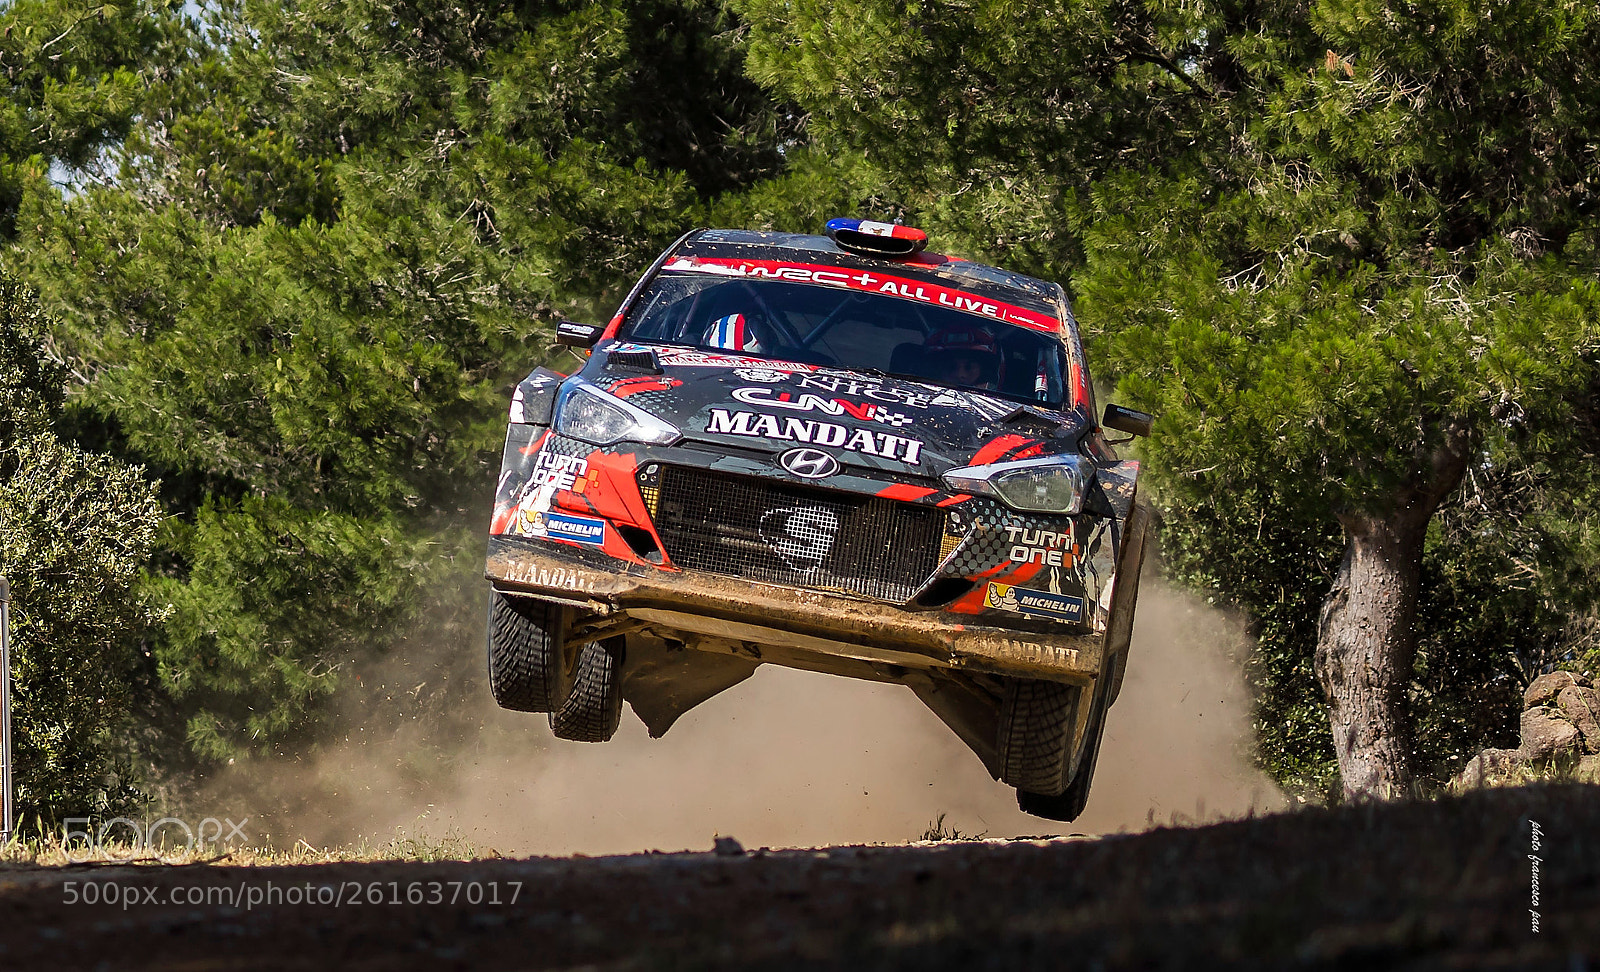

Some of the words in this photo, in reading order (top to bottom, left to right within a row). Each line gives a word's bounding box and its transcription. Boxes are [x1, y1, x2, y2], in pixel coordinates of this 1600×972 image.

[880, 282, 931, 301] ALL
[939, 293, 999, 317] LIVE
[796, 376, 929, 409] NICE
[706, 408, 924, 465] MANDATI
[538, 450, 588, 476] TURN
[548, 519, 603, 537] MICHELIN
[1004, 526, 1071, 550] TURN
[1010, 545, 1063, 567] ONE
[1020, 596, 1081, 613] MICHELIN
[984, 636, 1079, 665] ANDATI
